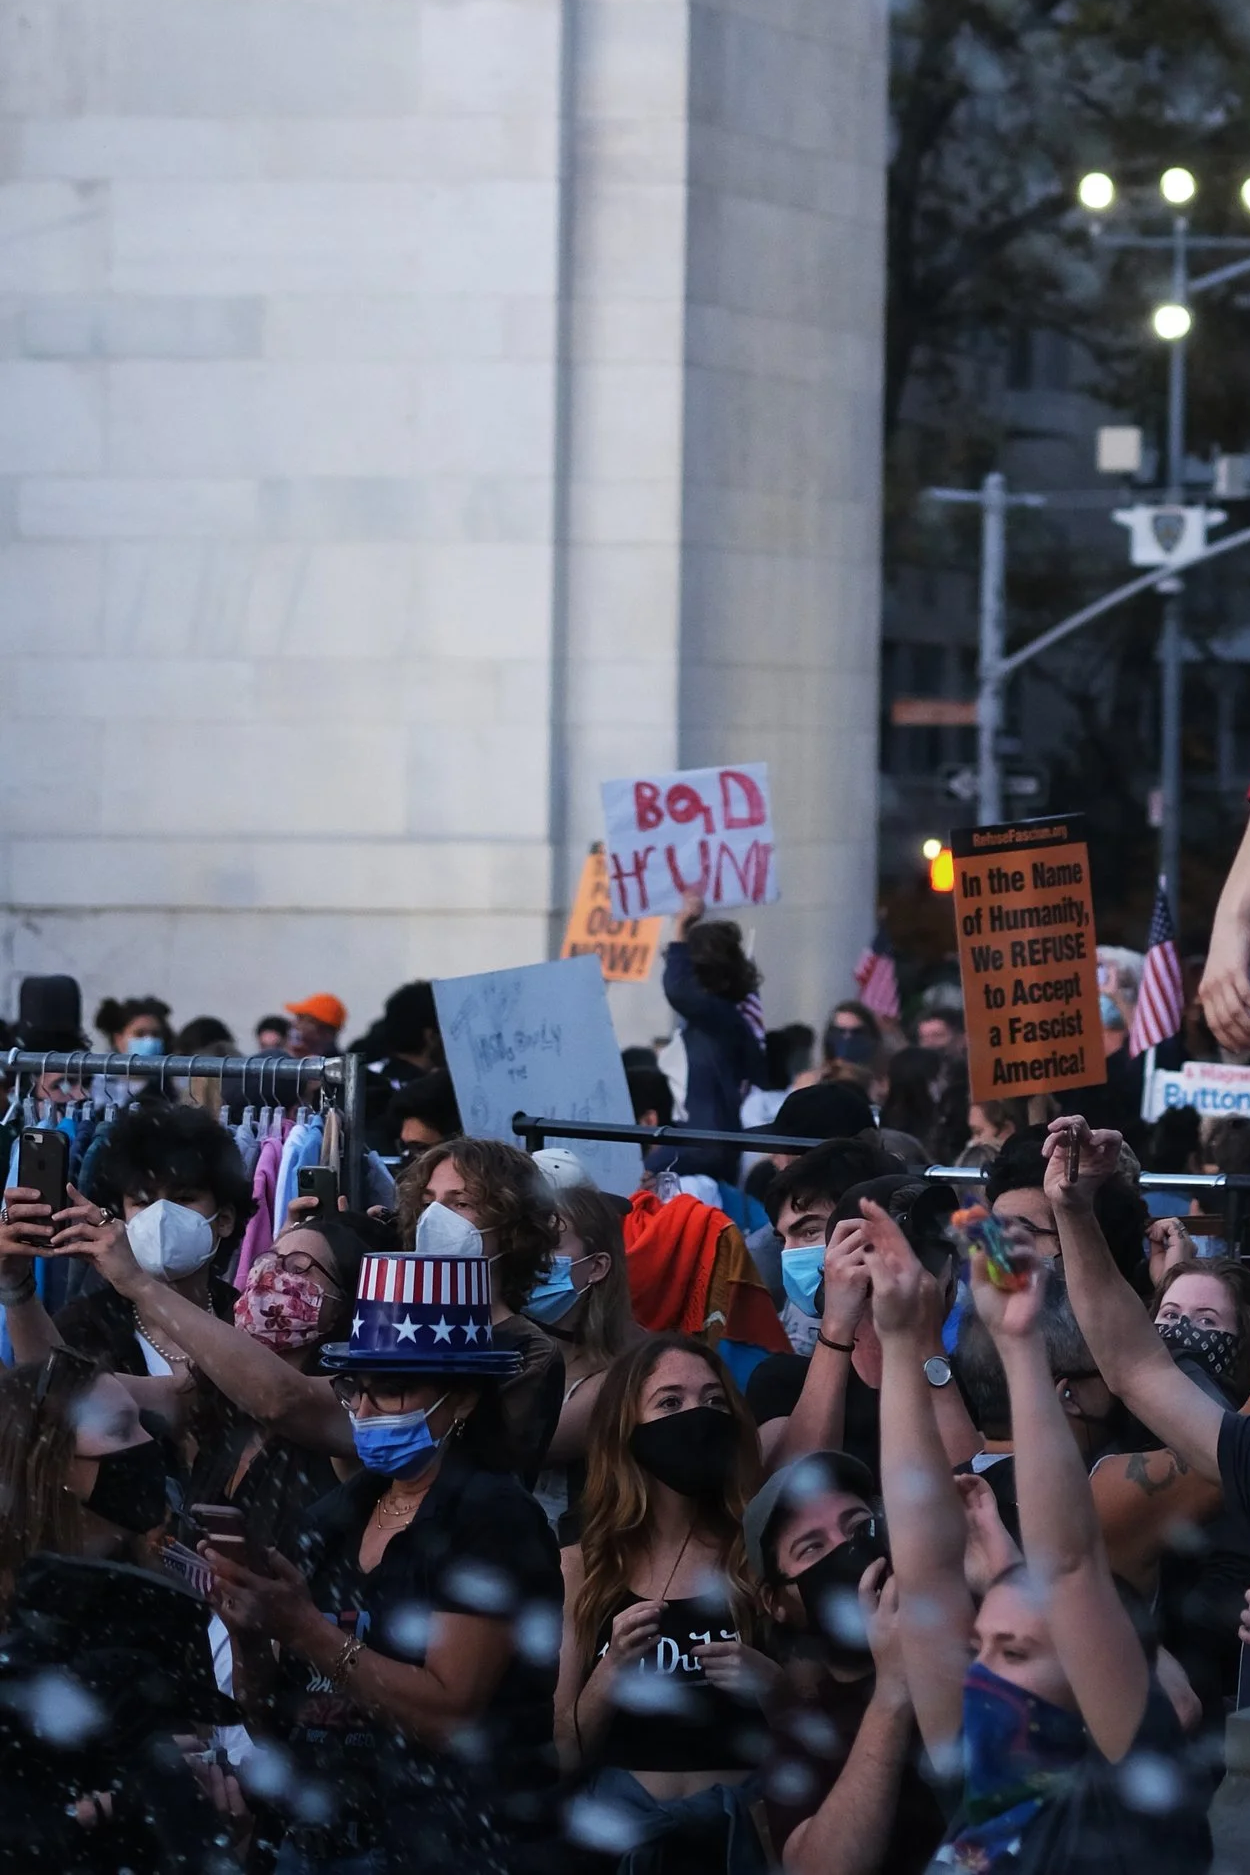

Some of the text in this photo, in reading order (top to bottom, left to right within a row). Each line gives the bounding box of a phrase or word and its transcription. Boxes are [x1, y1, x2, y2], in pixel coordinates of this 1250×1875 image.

[961, 862, 1083, 898] In the Name
[963, 897, 1089, 936] of Humanity,
[971, 932, 1087, 973] We REFUSE
[984, 972, 1082, 1010] to Accept
[989, 1009, 1084, 1047] a Fascist
[993, 1046, 1085, 1086] America!
